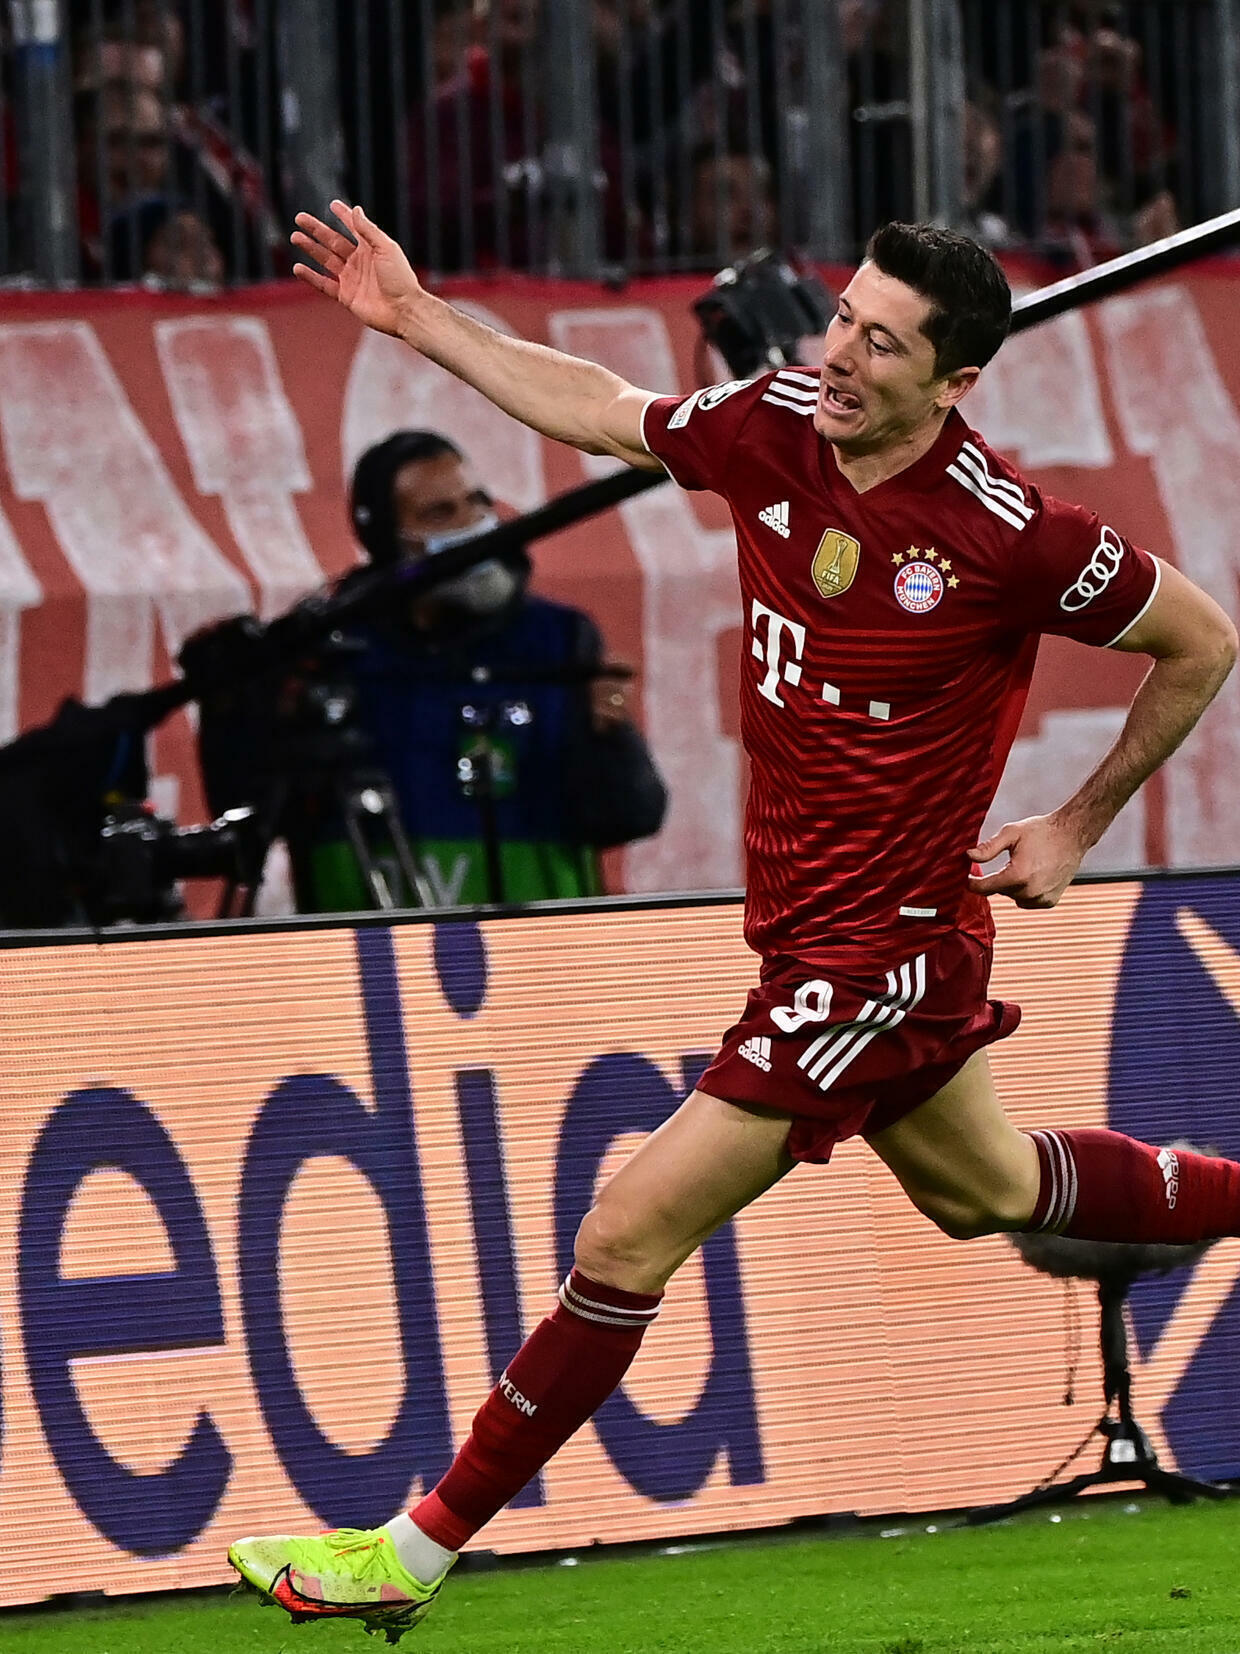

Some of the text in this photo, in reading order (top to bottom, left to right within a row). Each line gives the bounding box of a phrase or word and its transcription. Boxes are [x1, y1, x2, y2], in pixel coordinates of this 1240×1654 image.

[758, 510, 790, 539] adidas
[821, 570, 840, 585] FIFA
[901, 565, 941, 591] FC BAYERN
[751, 598, 806, 709] T
[770, 979, 834, 1033] 9
[738, 1043, 772, 1073] adidas
